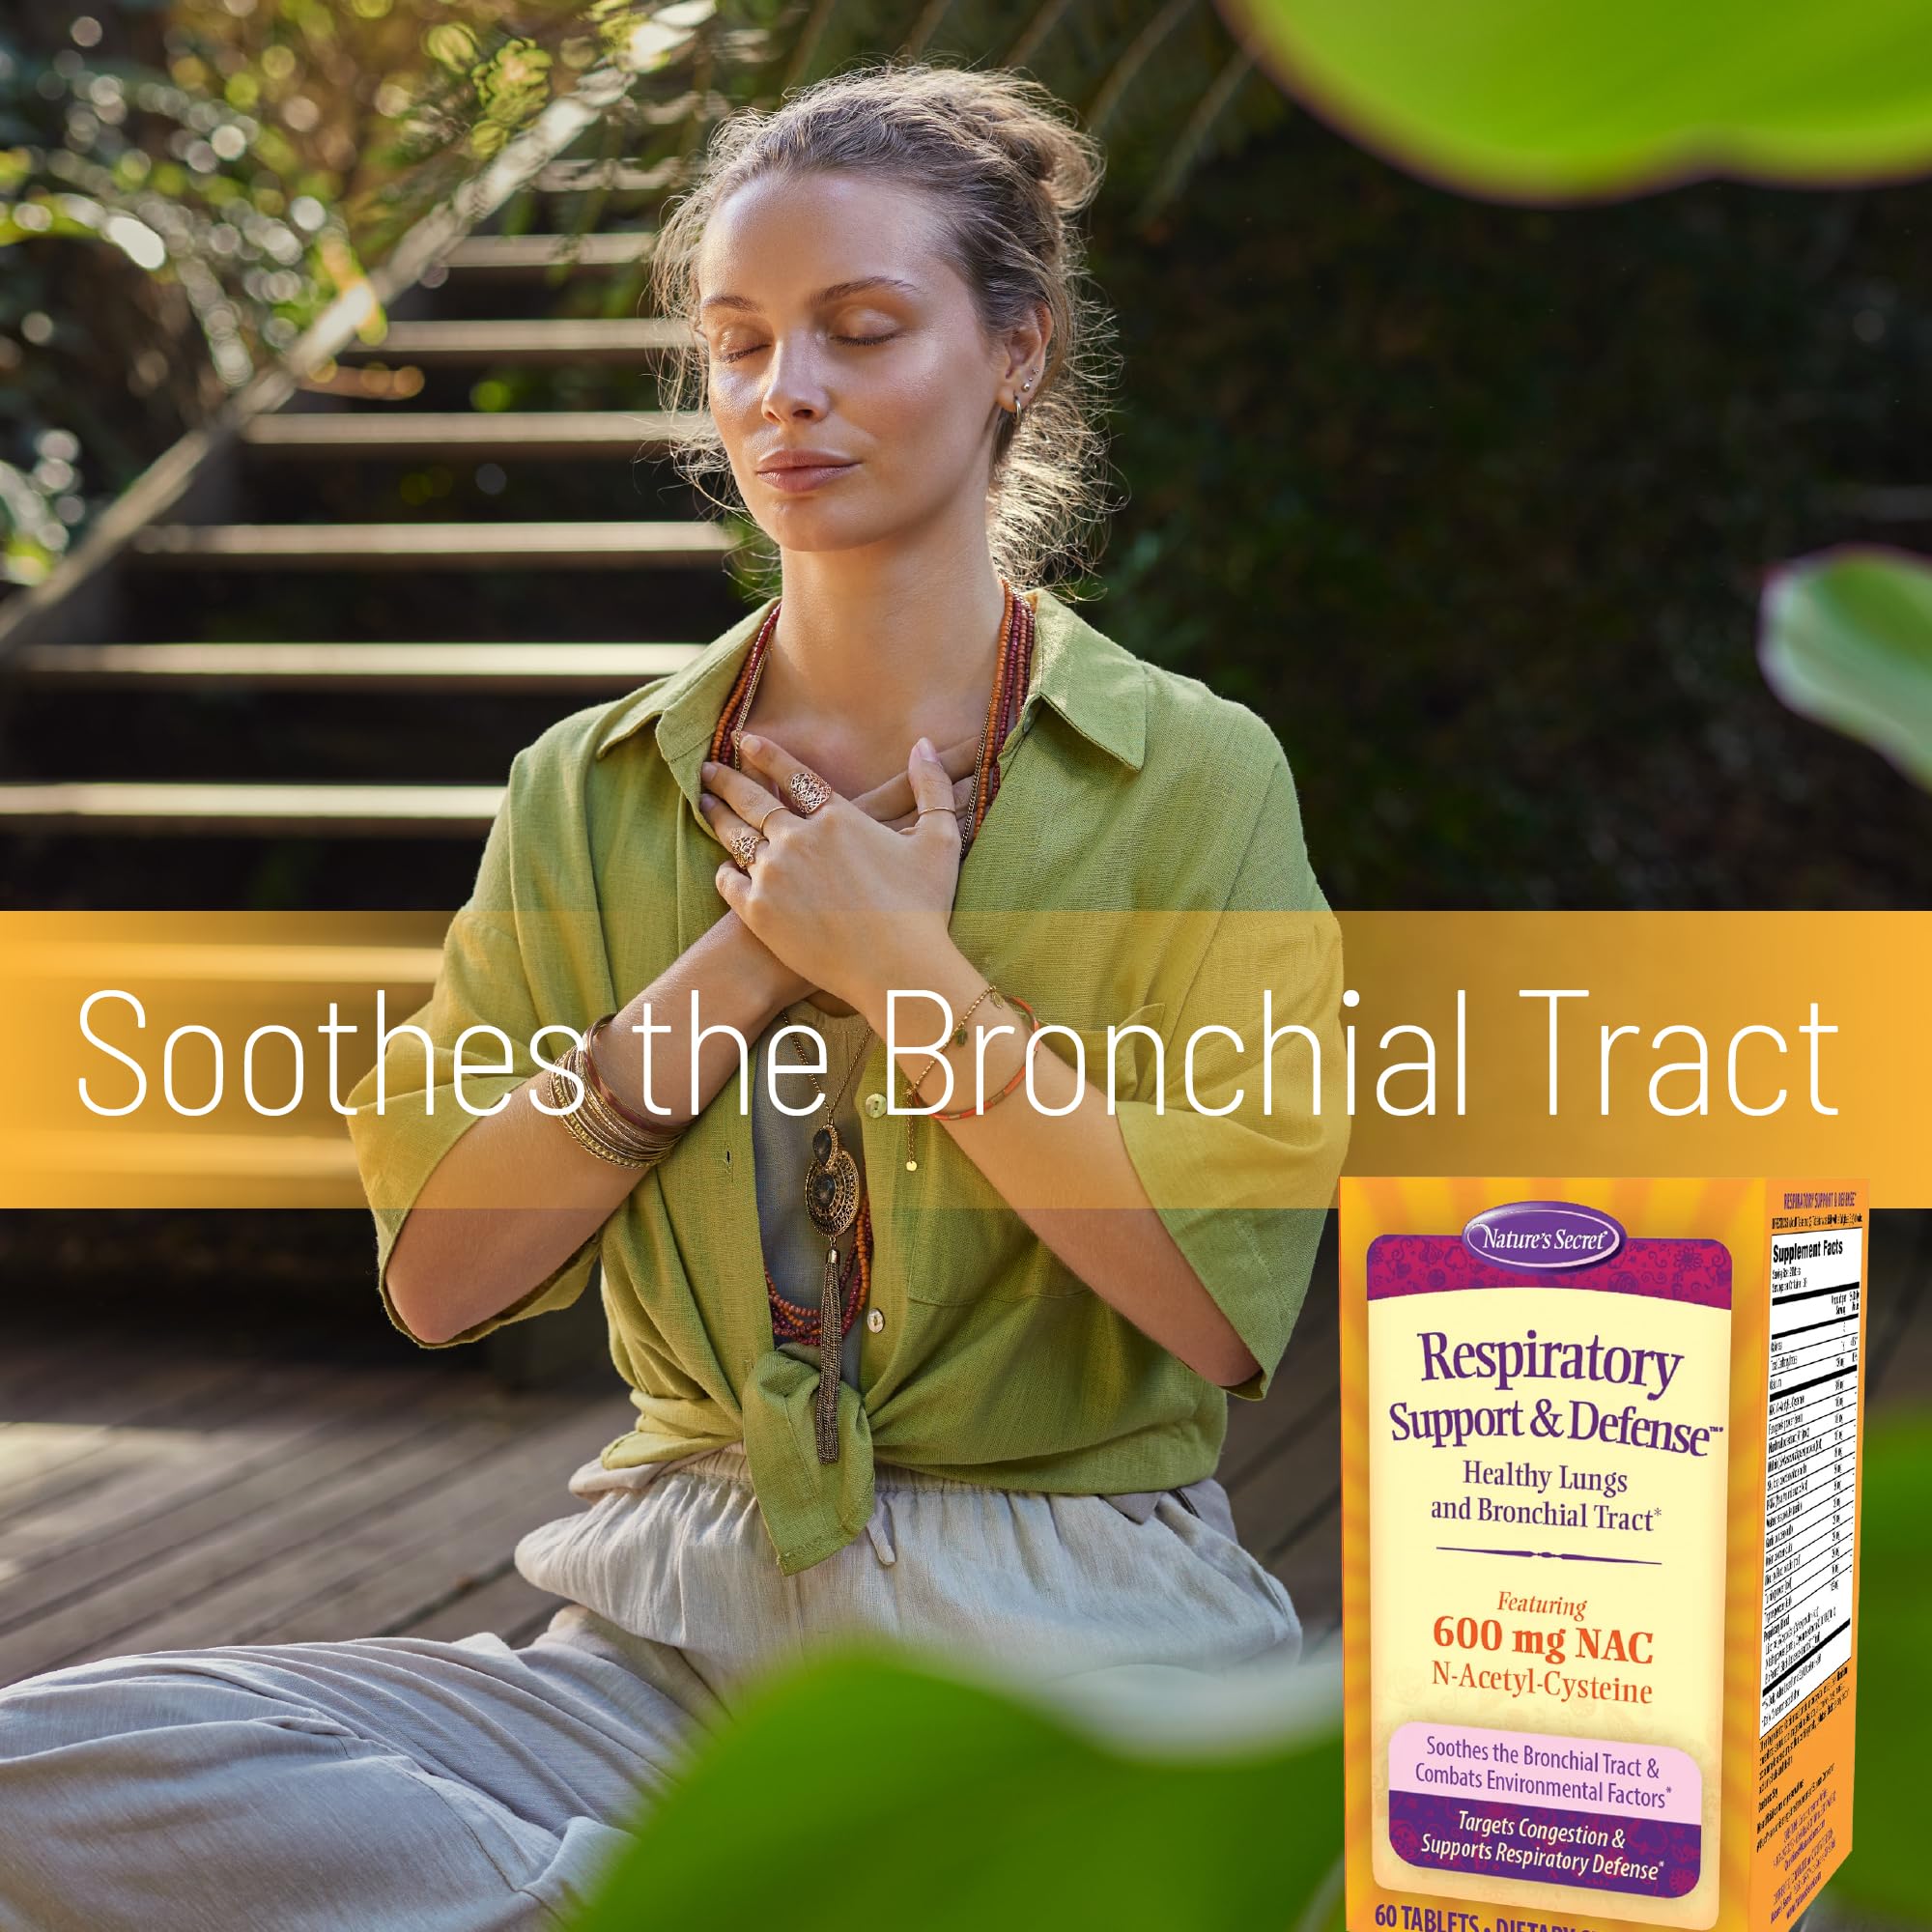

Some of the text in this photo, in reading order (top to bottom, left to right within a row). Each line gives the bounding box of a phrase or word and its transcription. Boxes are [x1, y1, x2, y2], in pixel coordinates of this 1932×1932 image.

[1482, 1227, 1551, 1250] Nature's
[1773, 1238, 1844, 1265] Supplement Facts
[1416, 1329, 1684, 1401] Respiratory
[1388, 1402, 1524, 1448] Support
[1529, 1398, 1564, 1439] &
[1463, 1460, 1629, 1498] Healthy Lungs
[1431, 1496, 1471, 1521] and
[1477, 1497, 1587, 1528] Bronchial
[1497, 1591, 1587, 1623] Featuring
[1433, 1615, 1655, 1665] 600 mg NAC
[1431, 1659, 1654, 1705] N-Acetyl-Cysteine
[1426, 1735, 1661, 1779] Soothes the Bronchial Tract &
[1415, 1762, 1483, 1789] Combats
[1487, 1770, 1604, 1802] Environmental
[1459, 1809, 1627, 1850] Targets Congestion &
[1421, 1833, 1492, 1861] Supports
[1495, 1841, 1590, 1877] Respiratory
[1375, 1903, 1398, 1928] 60
[1401, 1905, 1479, 1932] TABLETS
